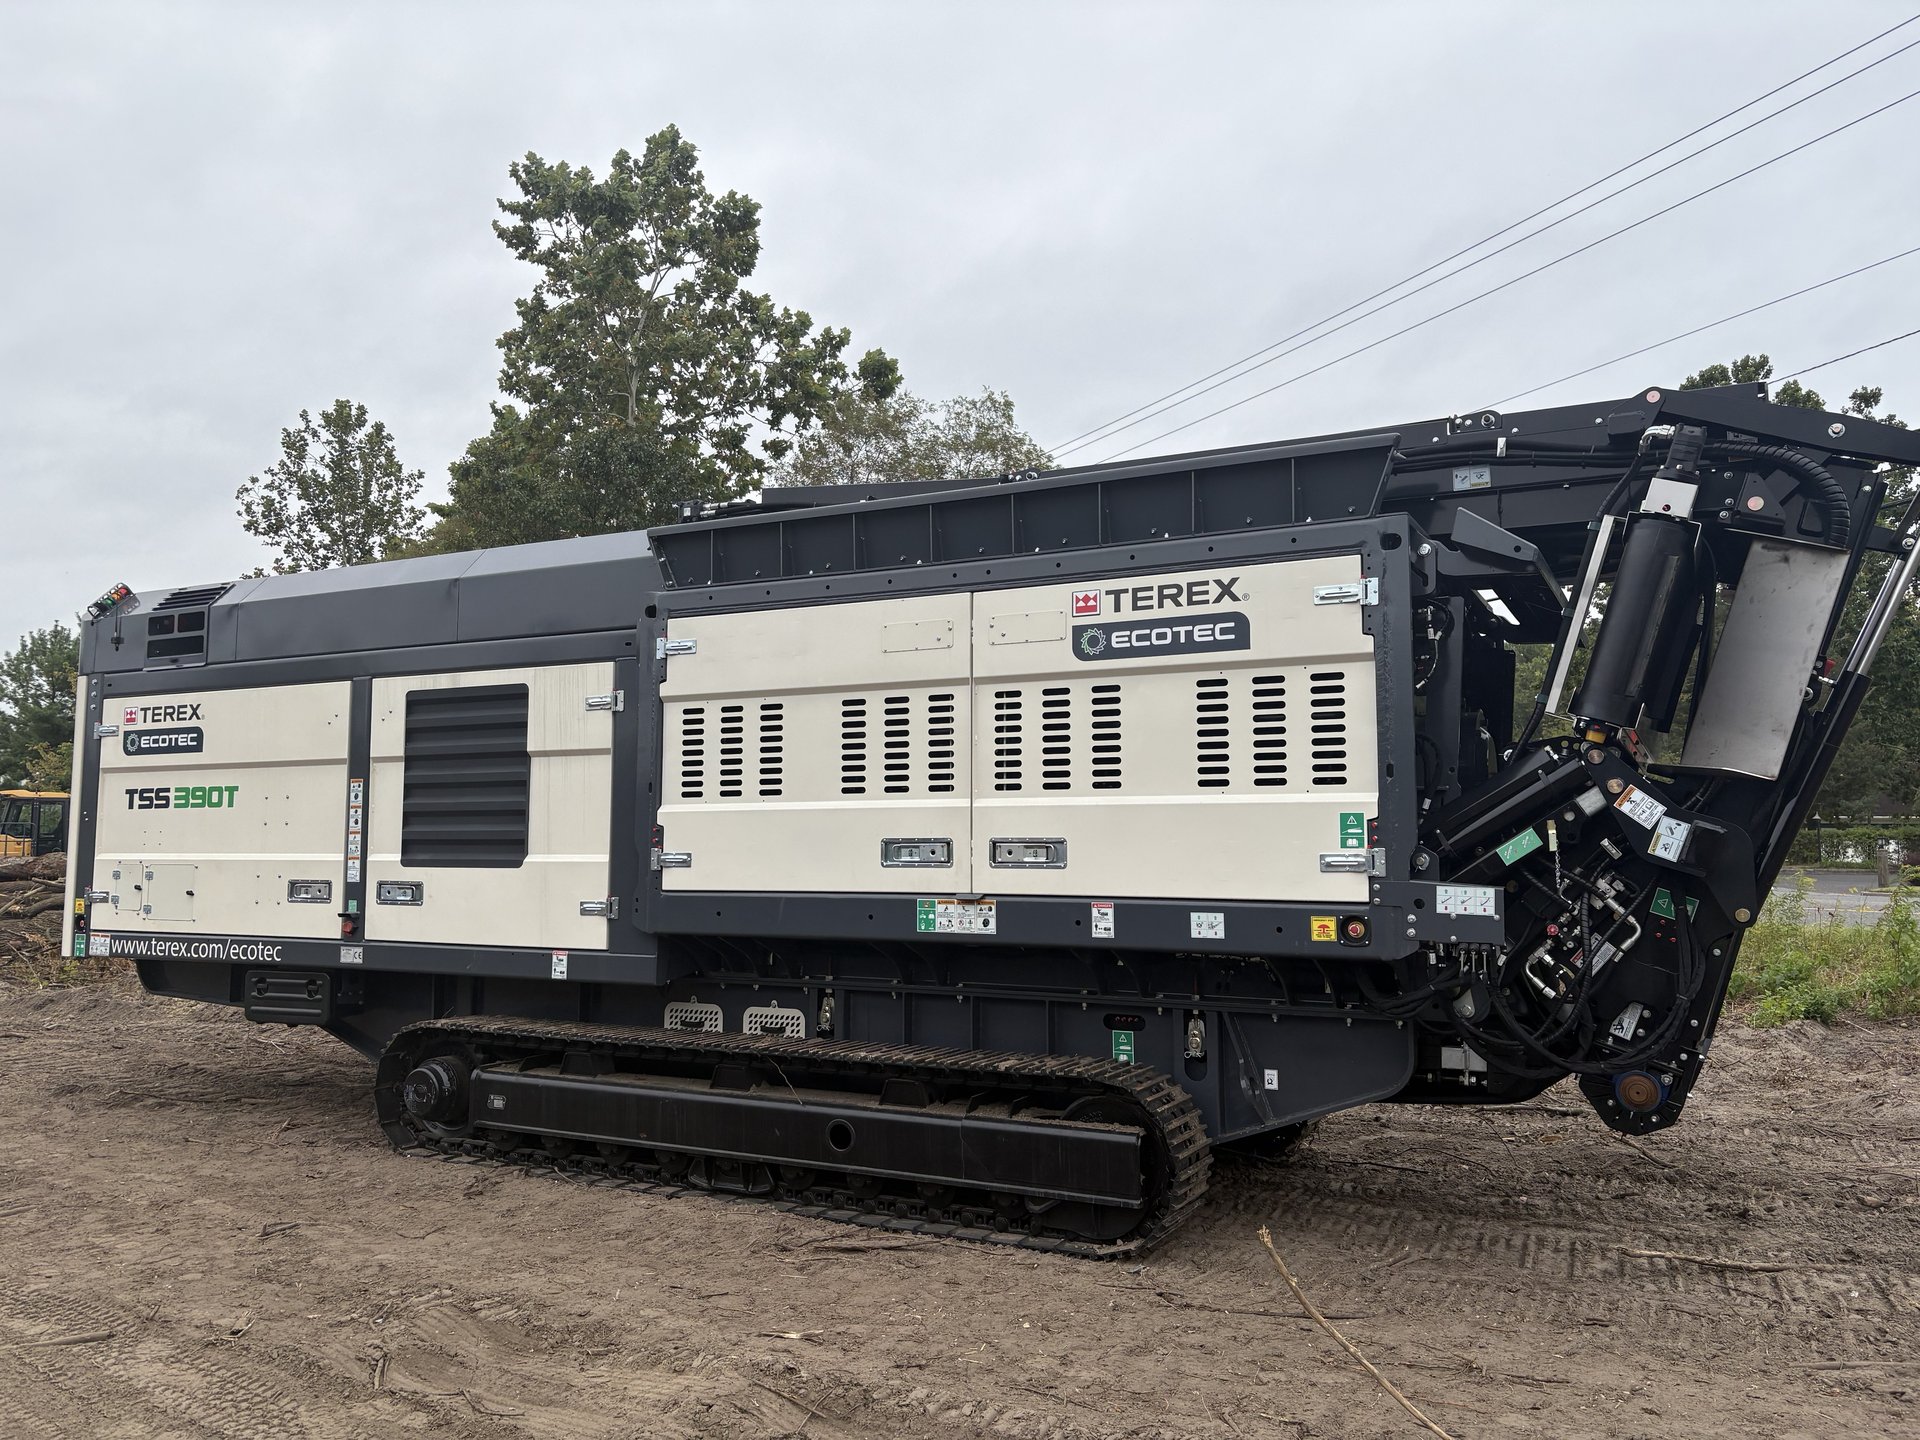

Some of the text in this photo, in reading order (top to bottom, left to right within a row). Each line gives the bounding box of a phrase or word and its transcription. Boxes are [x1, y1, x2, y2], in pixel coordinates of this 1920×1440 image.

[1105, 576, 1242, 613] TEREX
[1111, 622, 1235, 649] ECOTEC
[140, 703, 202, 724] TEREX
[140, 733, 198, 748] ECOTEC
[125, 785, 239, 810] TSS 390T
[111, 938, 282, 961] www.terex.com/ecotec
